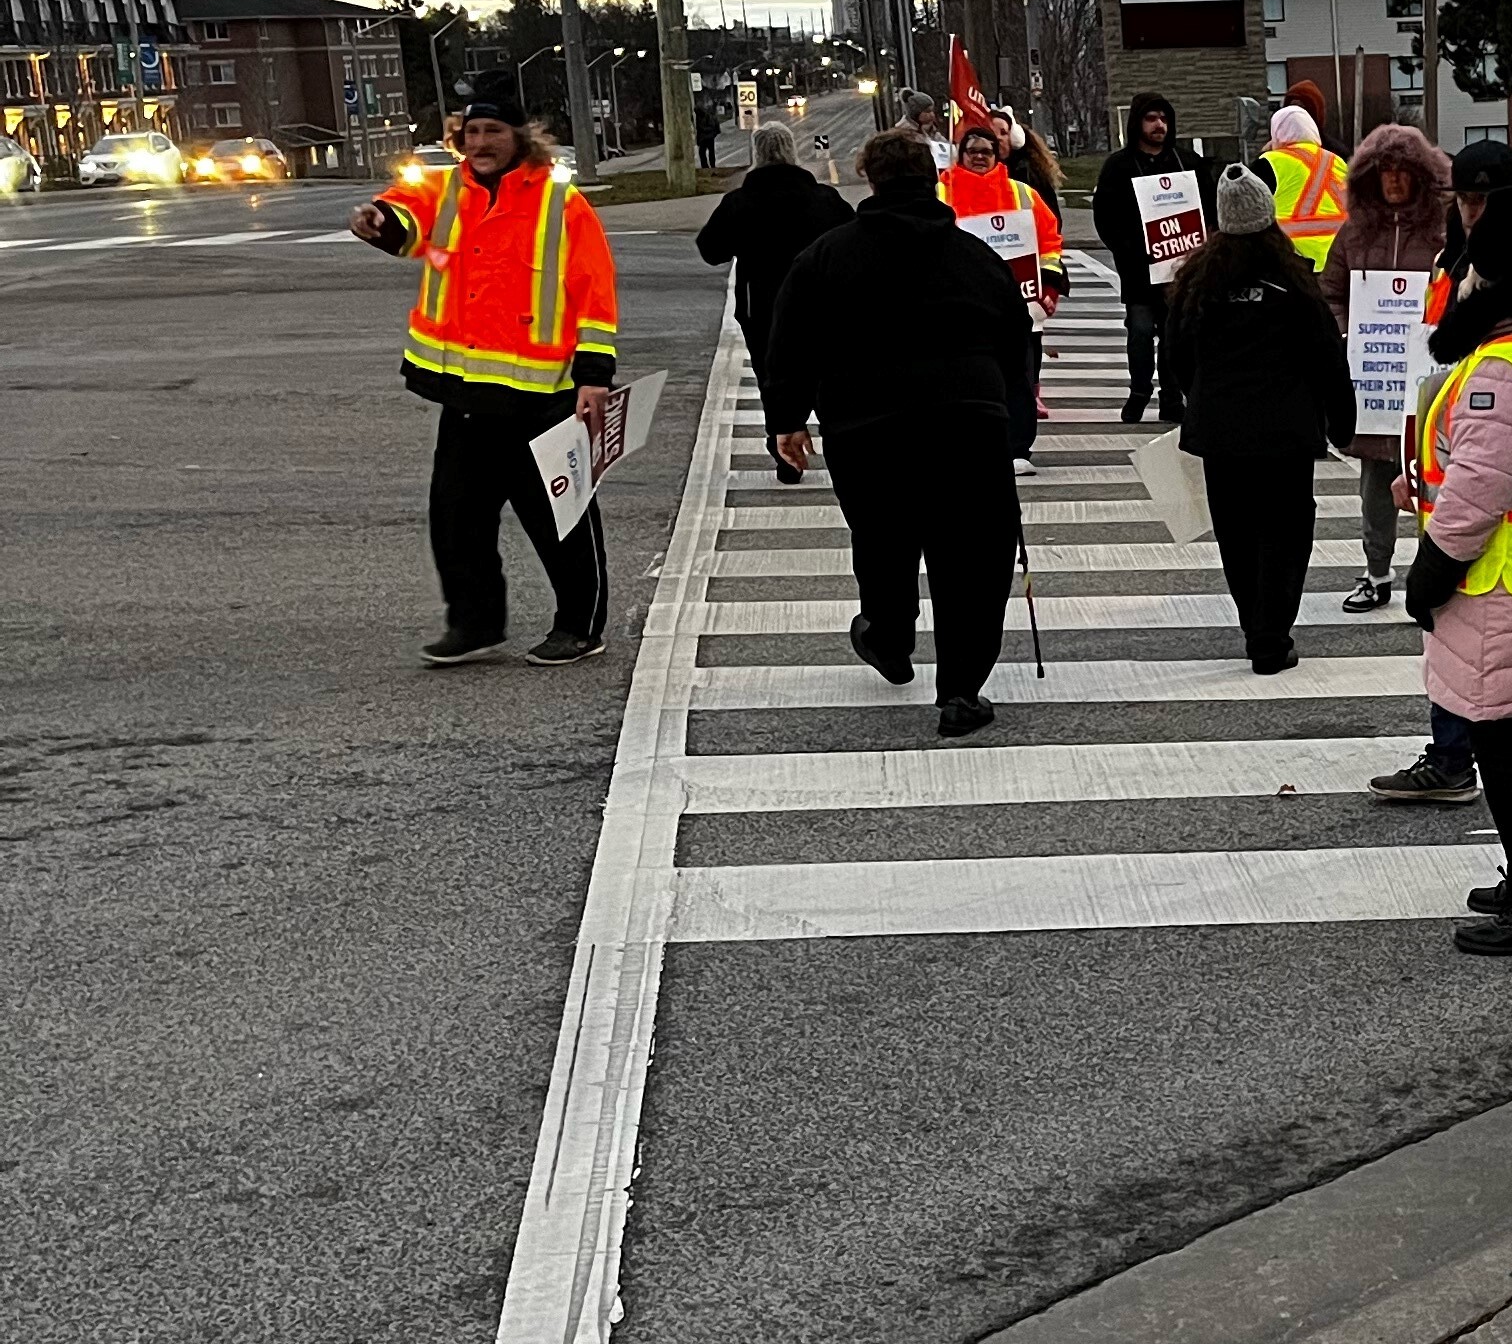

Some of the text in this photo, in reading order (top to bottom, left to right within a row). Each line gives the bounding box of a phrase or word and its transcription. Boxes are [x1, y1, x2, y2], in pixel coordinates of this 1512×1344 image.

[739, 90, 756, 102] 50
[1159, 218, 1181, 237] ON
[1152, 232, 1201, 258] STRIKE
[1358, 323, 1411, 335] SUPPORT
[1363, 342, 1406, 354] SISTERS
[1364, 398, 1405, 411] FOR JUS
[603, 392, 626, 464] STRIKE
